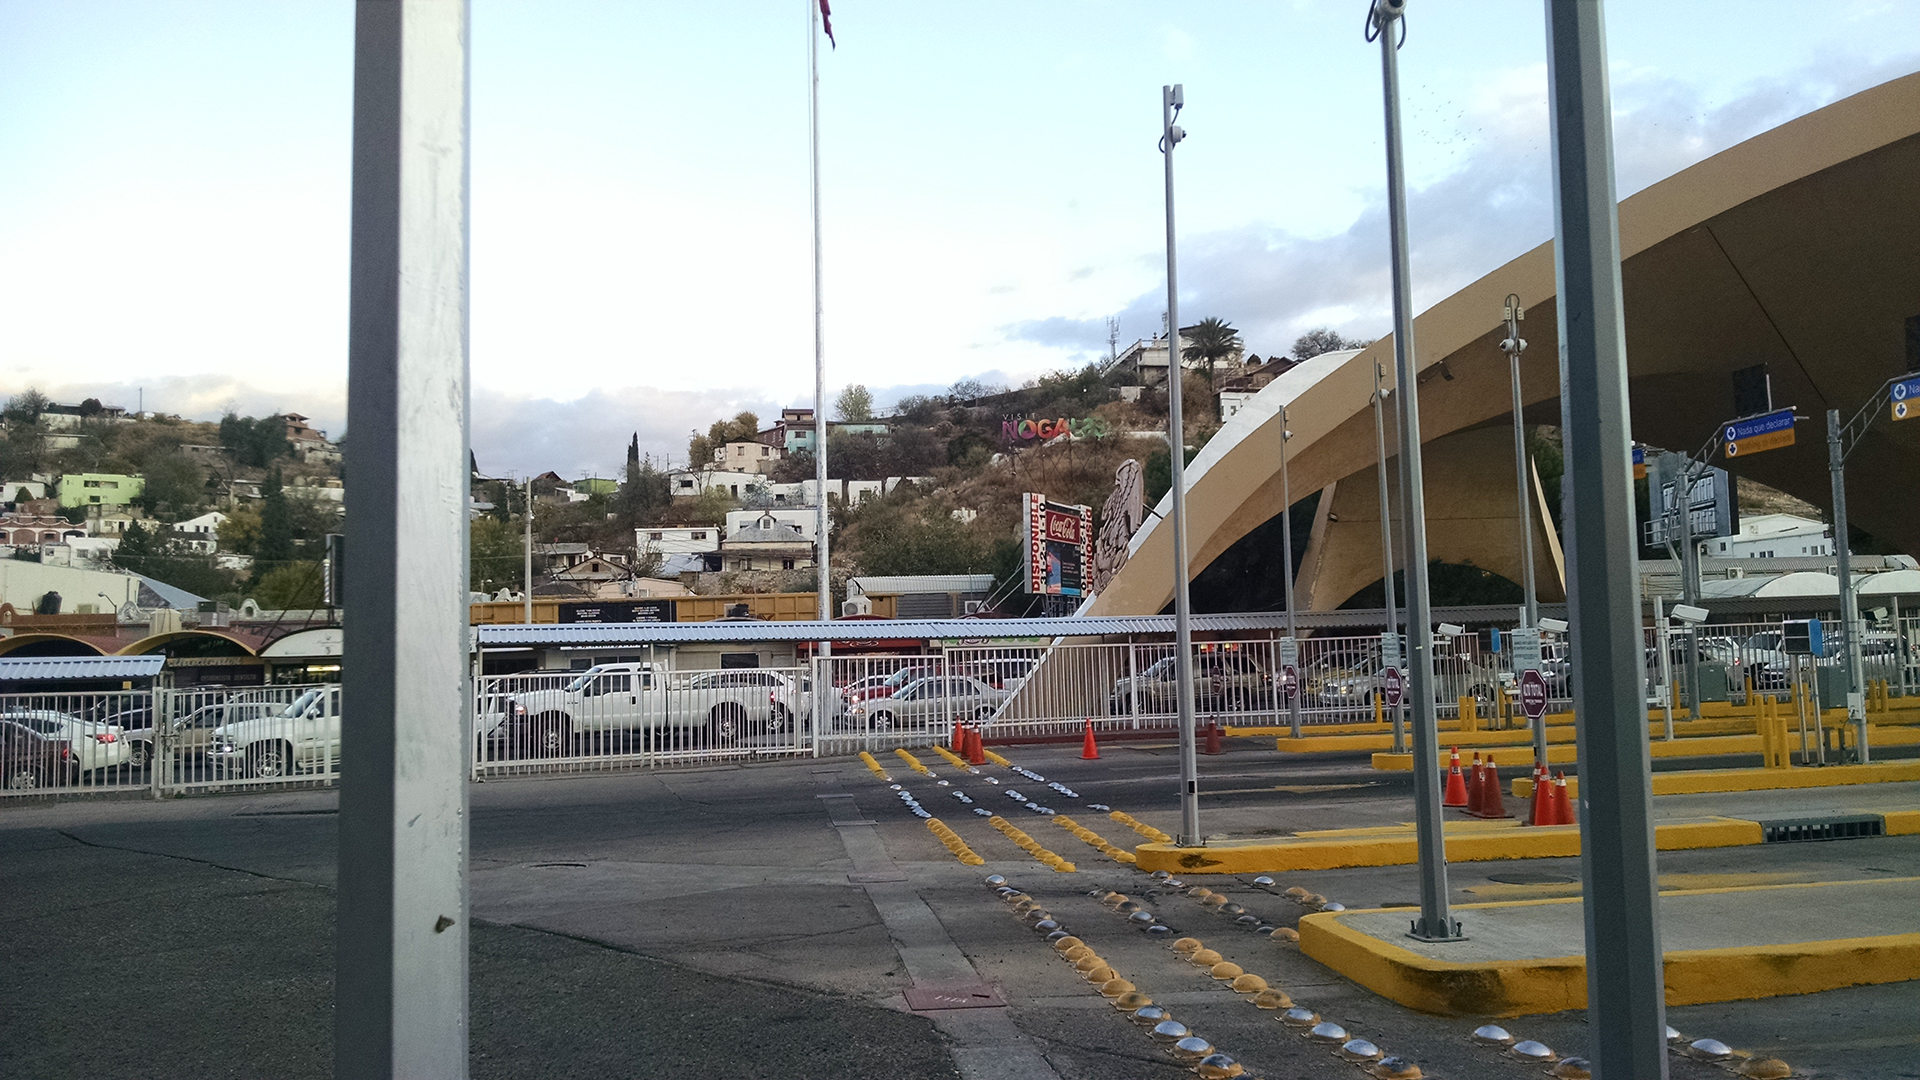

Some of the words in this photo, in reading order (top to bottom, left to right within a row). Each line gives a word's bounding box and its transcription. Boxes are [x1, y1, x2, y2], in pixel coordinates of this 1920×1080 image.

[1908, 384, 1920, 395] Na
[1002, 412, 1036, 420] VISIT
[1737, 425, 1753, 437] Nada
[1753, 422, 1765, 434] que
[1766, 417, 1790, 431] declarar
[1031, 494, 1040, 592] DISPONIBLE
[1039, 502, 1047, 585] 31-2-11-10
